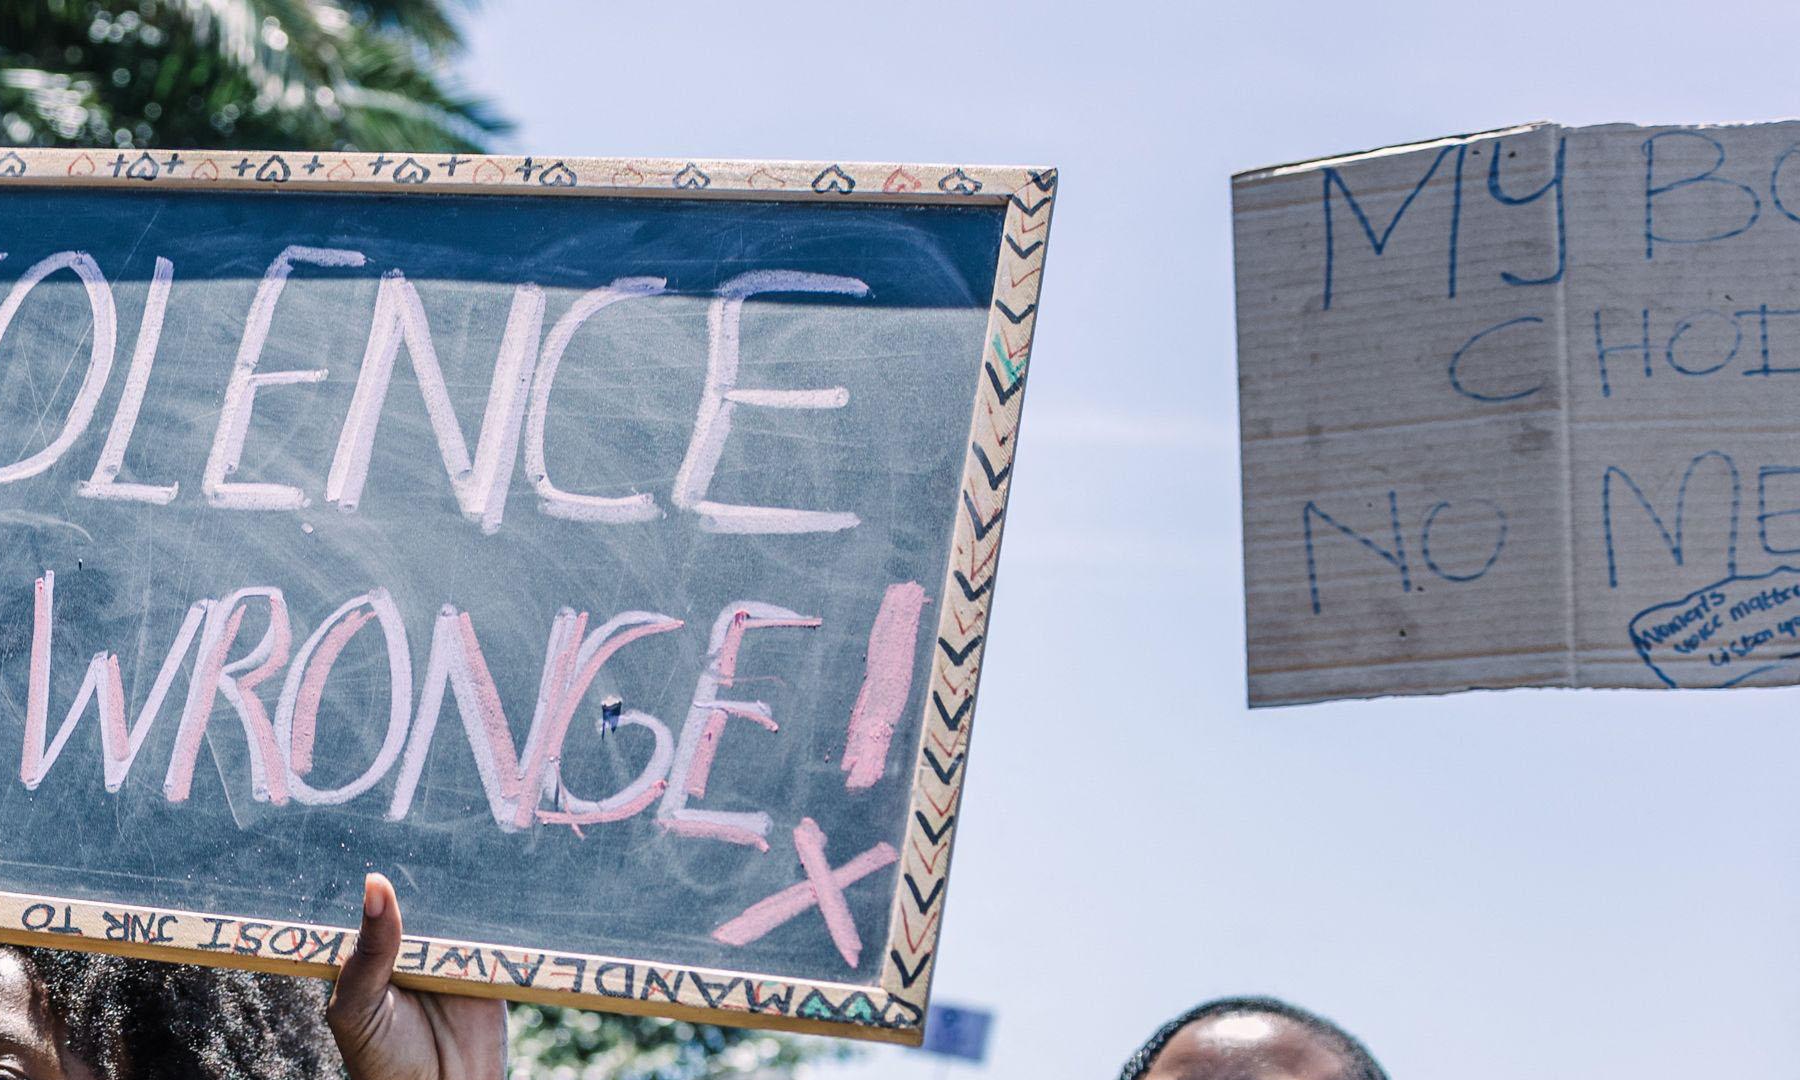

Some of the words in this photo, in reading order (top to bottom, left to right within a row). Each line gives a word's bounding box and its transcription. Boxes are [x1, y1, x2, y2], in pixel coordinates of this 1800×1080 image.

[1321, 138, 1566, 310] MY
[1303, 490, 1507, 614] NO
[21, 903, 83, 937] TO
